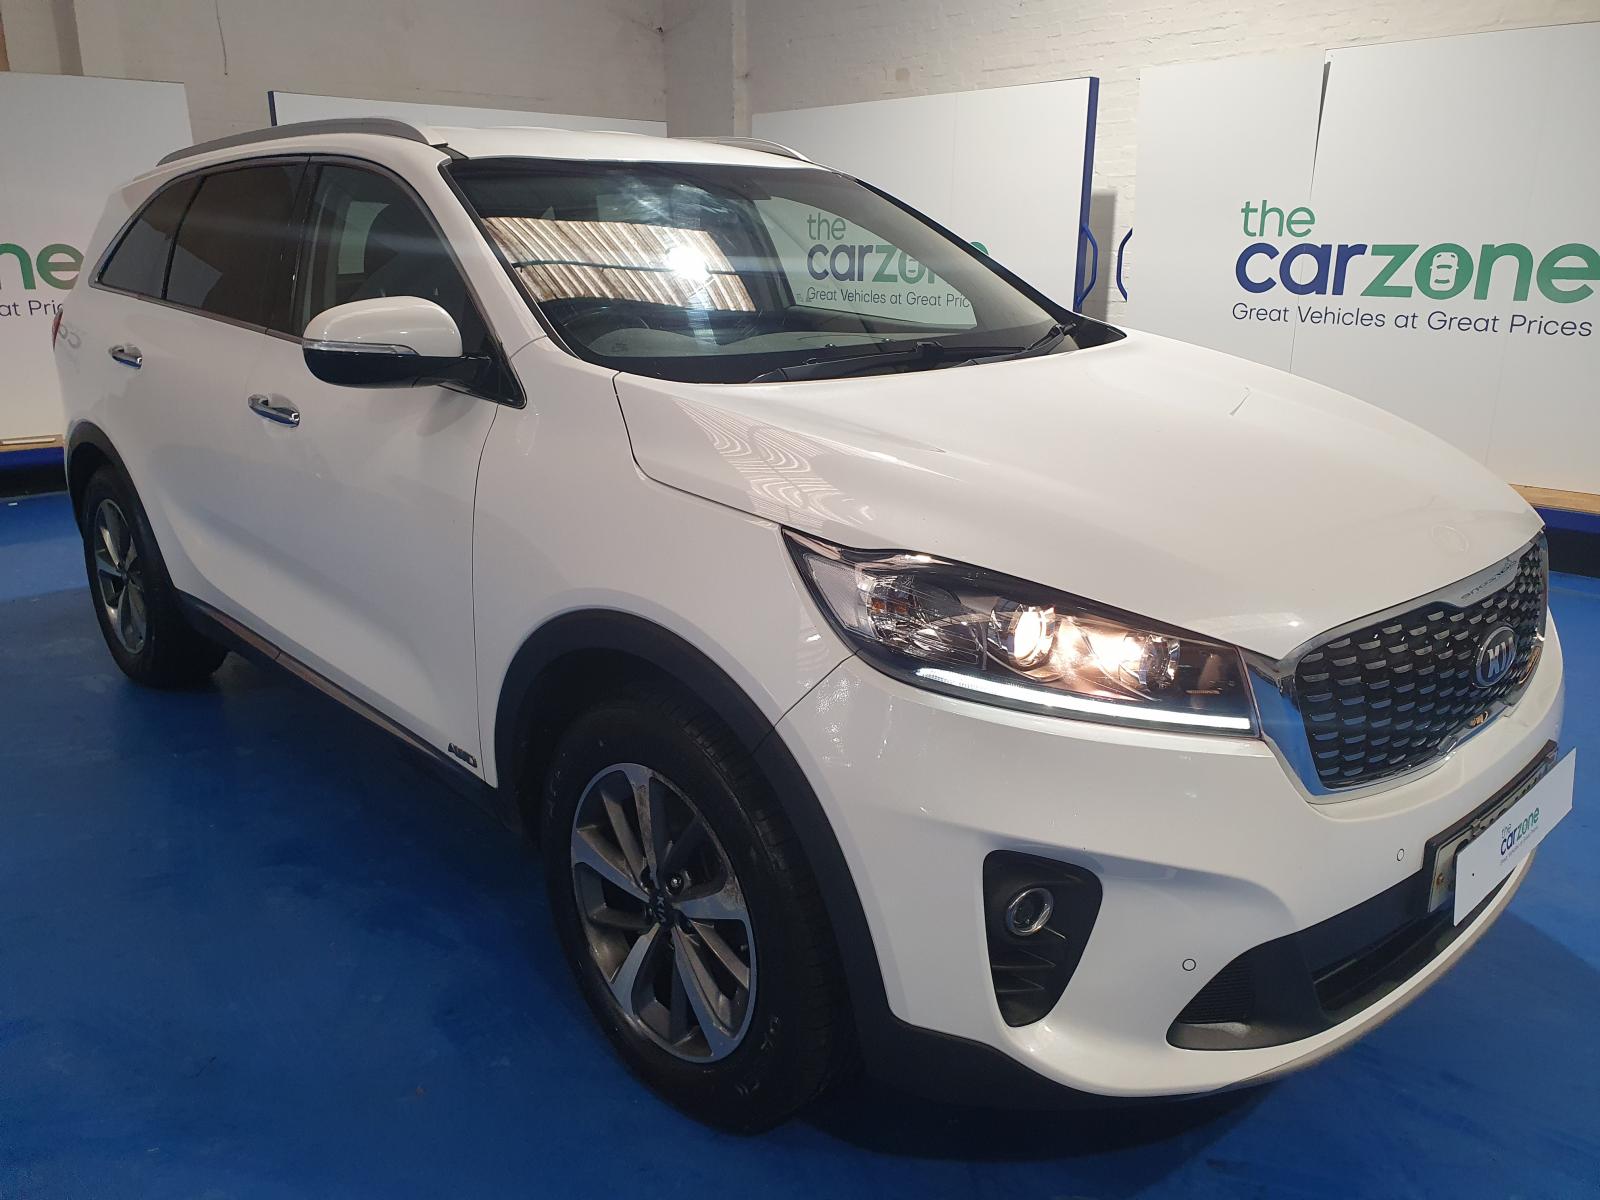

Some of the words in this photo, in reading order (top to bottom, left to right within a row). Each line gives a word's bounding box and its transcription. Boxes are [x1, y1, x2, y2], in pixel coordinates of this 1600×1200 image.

[807, 213, 846, 240] the
[1241, 200, 1316, 237] the
[807, 241, 989, 285] carzo
[1236, 242, 1600, 304] carzone
[807, 287, 837, 301] Great
[841, 289, 886, 304] Vehicles
[890, 294, 902, 305] at
[906, 292, 941, 306] Great
[1232, 302, 1289, 322] Great
[1298, 305, 1386, 328] Vehicles
[1394, 312, 1418, 329] at
[1427, 311, 1500, 332] Great
[1509, 314, 1593, 337] Prices
[1500, 807, 1540, 856] carzone
